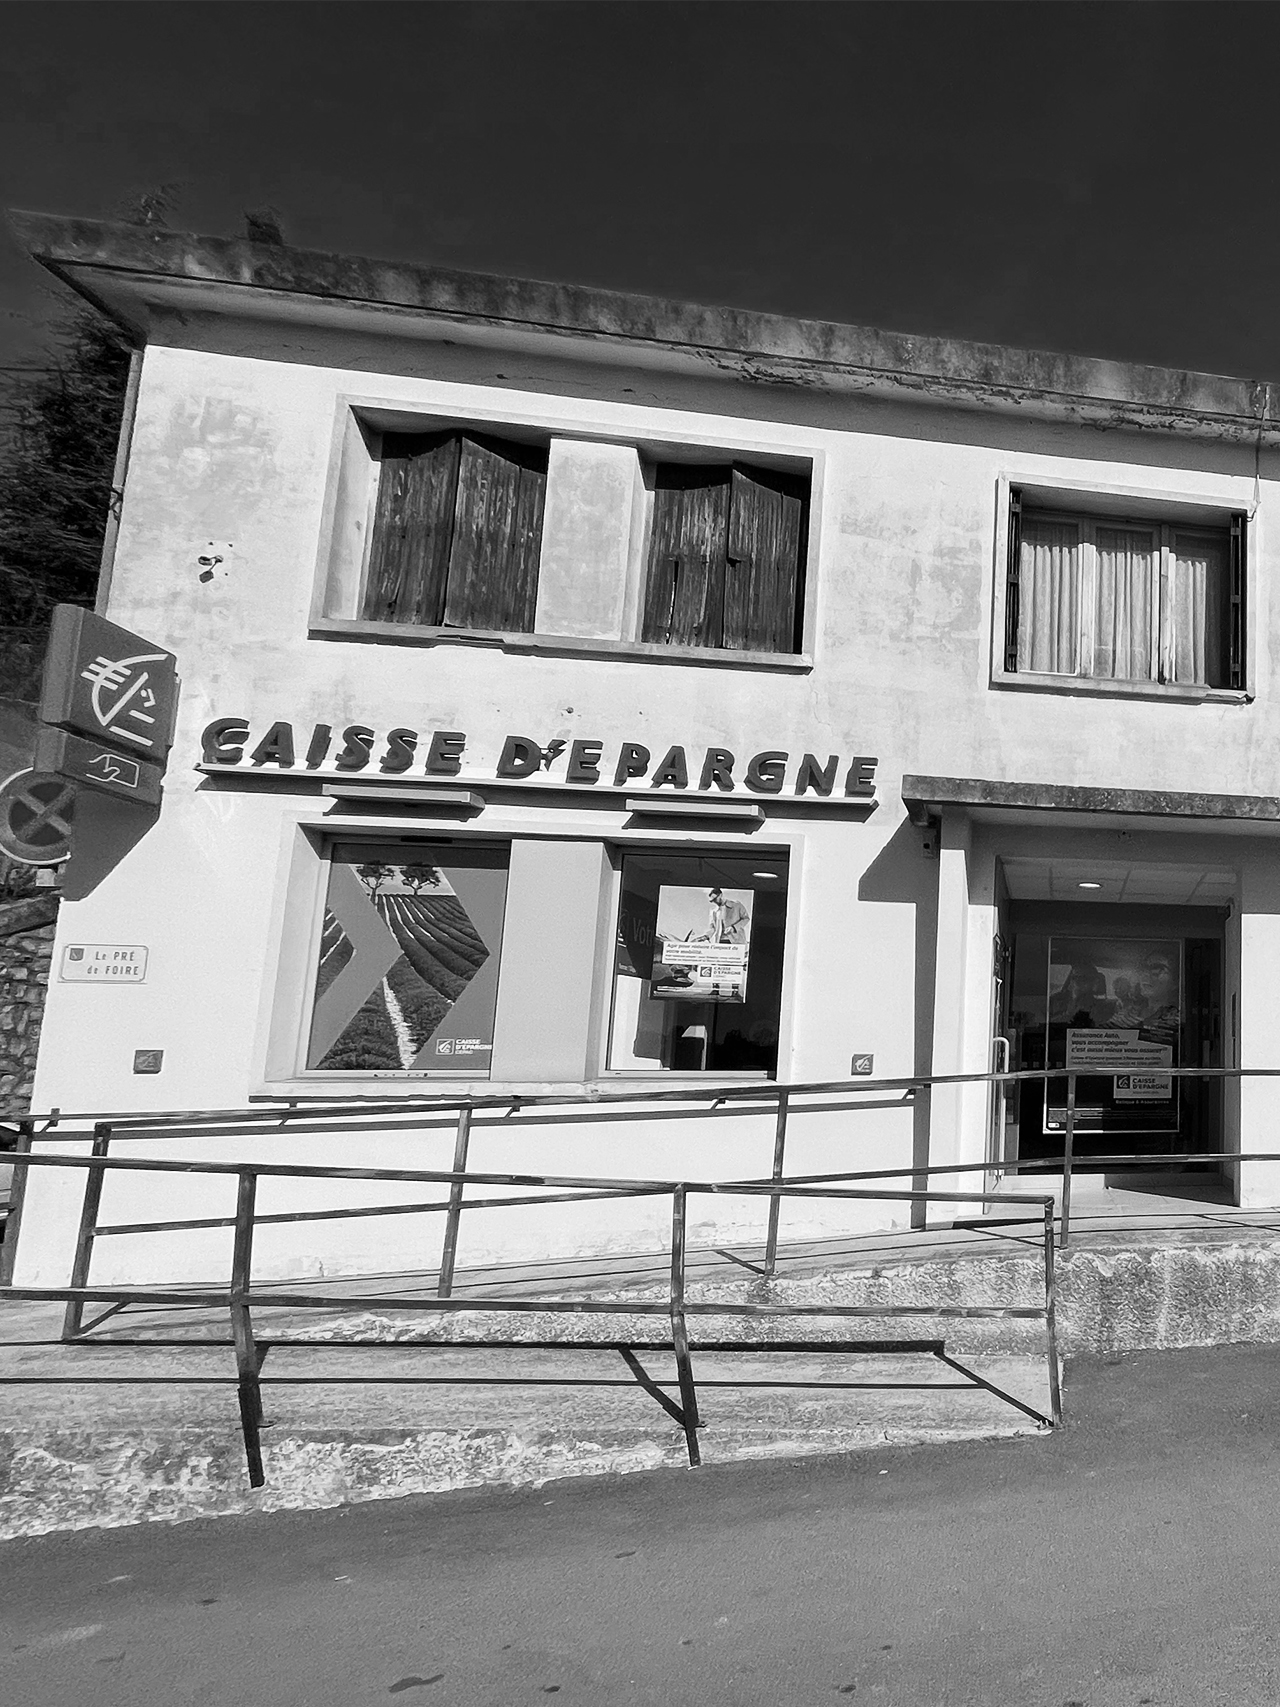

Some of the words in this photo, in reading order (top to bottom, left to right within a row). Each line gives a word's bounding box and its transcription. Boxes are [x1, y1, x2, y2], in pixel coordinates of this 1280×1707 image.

[201, 717, 467, 777] CAISSE
[95, 951, 107, 960] Le
[87, 965, 98, 974] de
[105, 965, 139, 975] FOIRE
